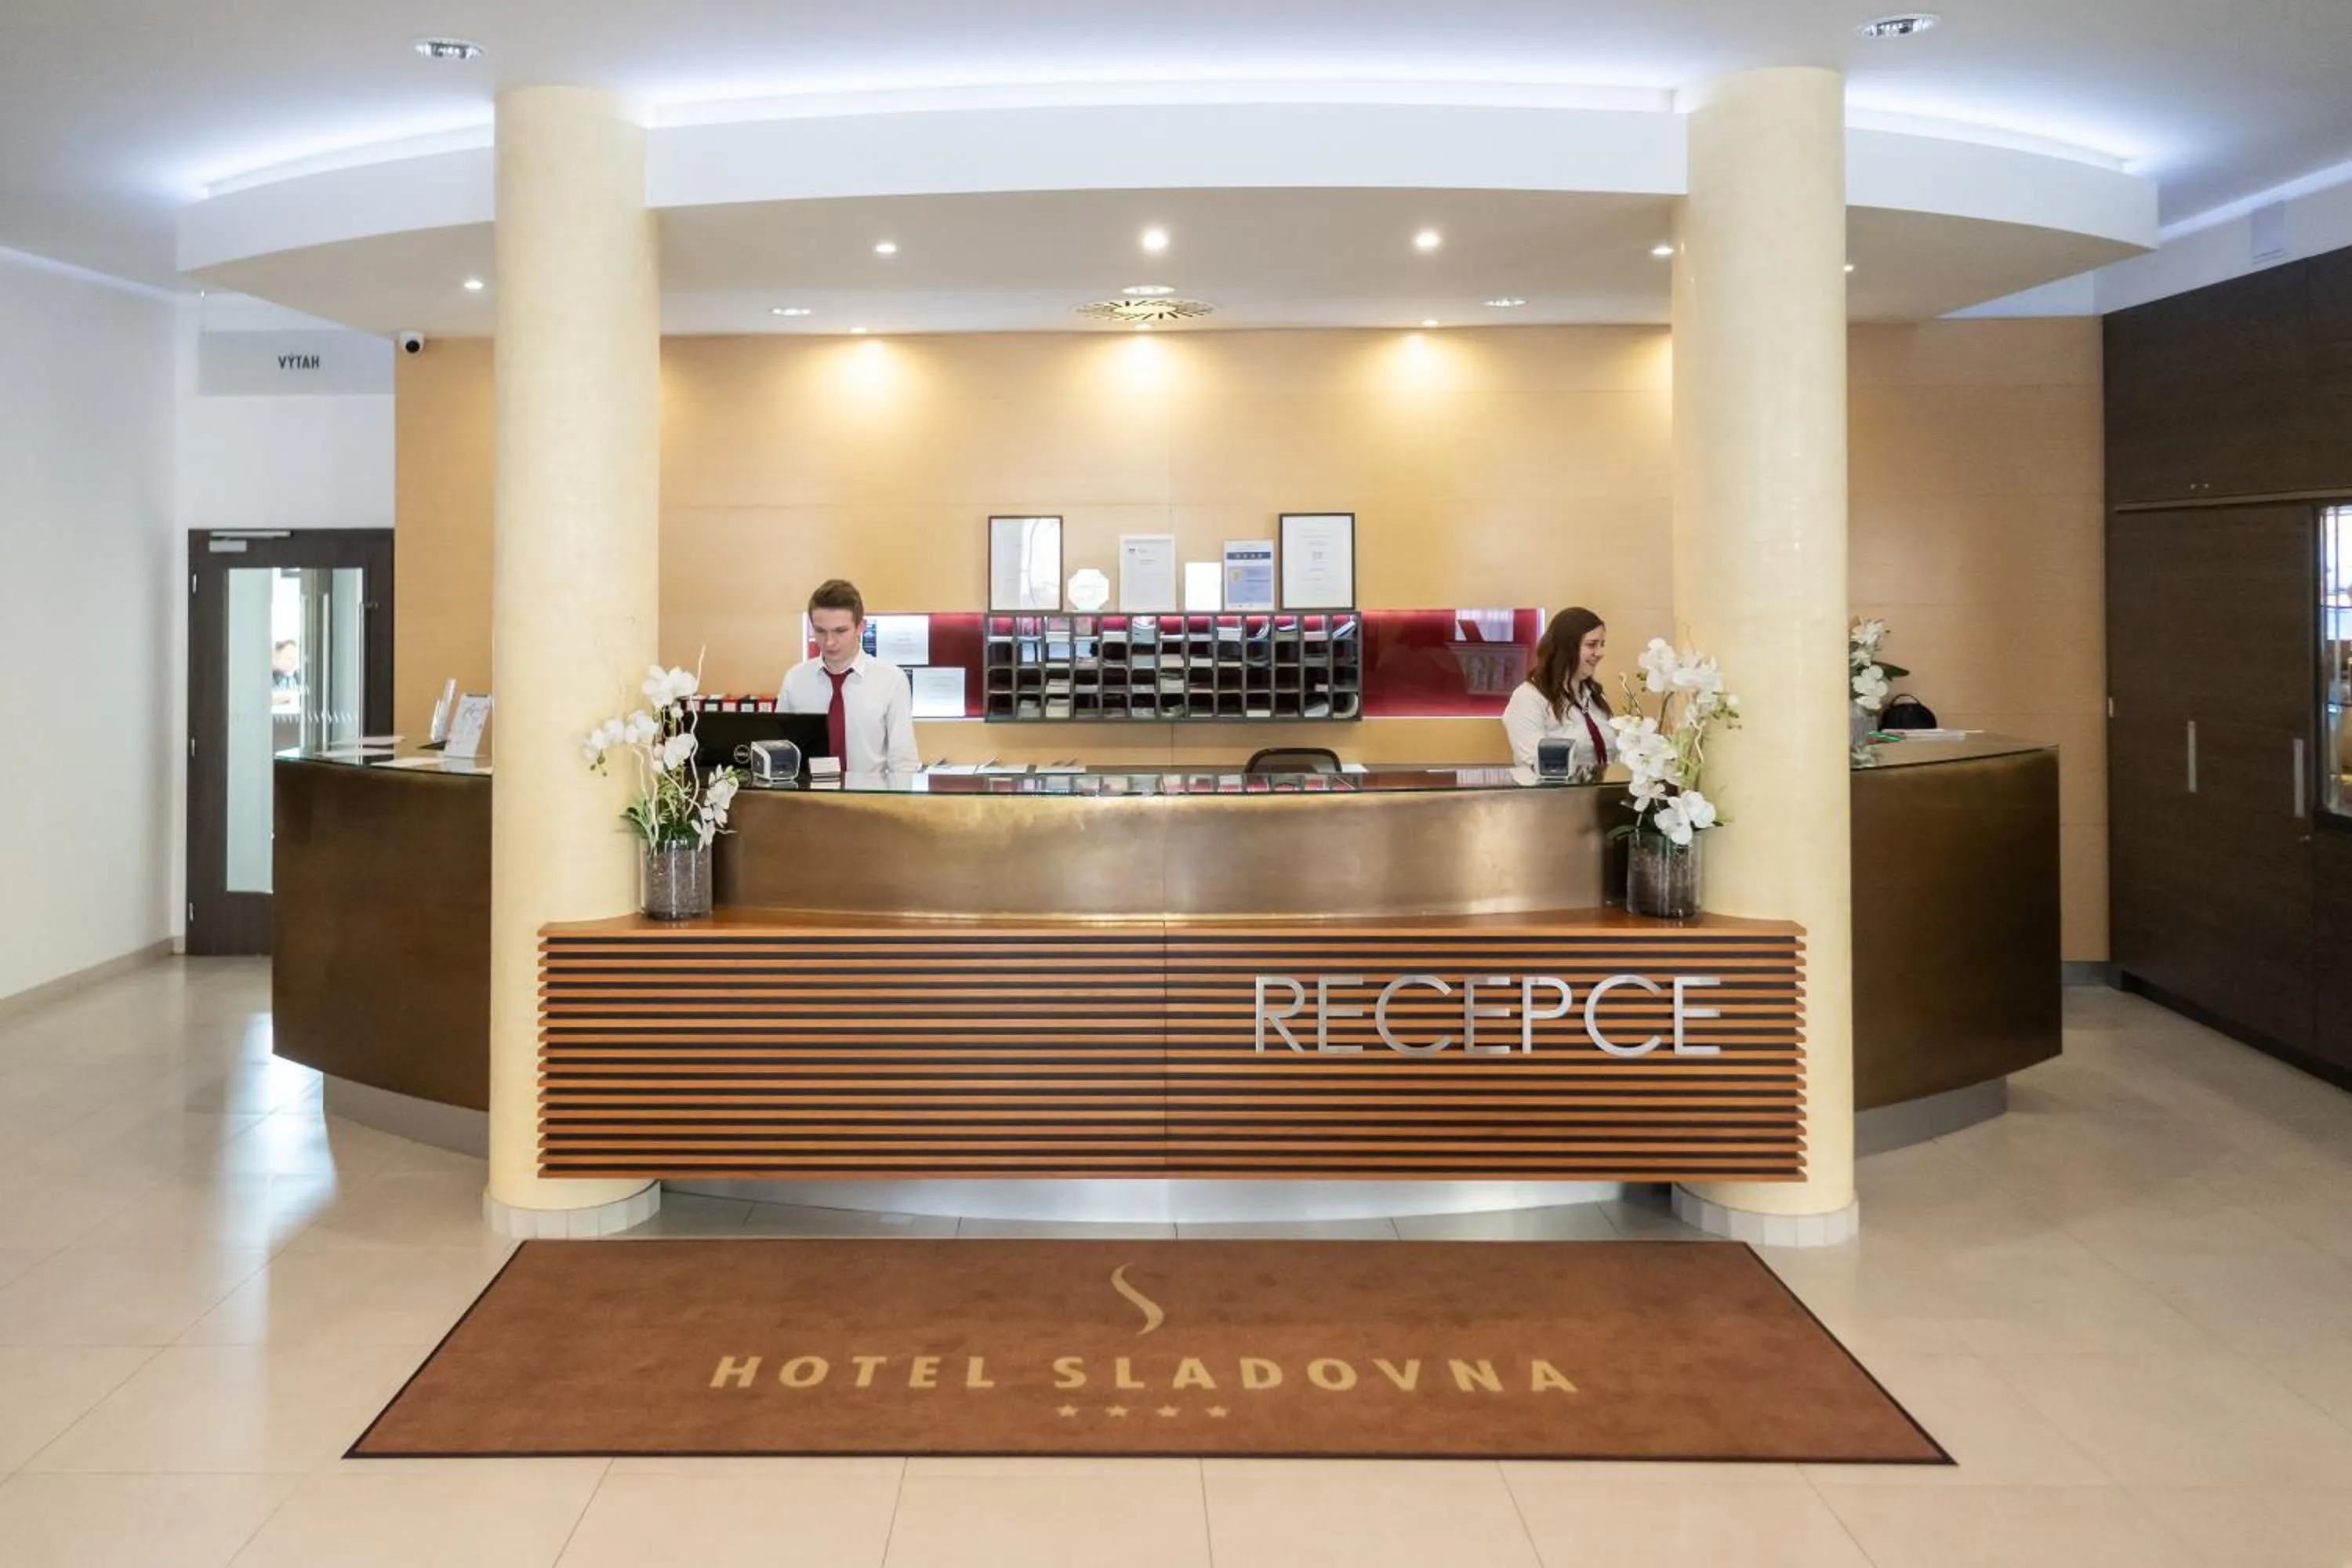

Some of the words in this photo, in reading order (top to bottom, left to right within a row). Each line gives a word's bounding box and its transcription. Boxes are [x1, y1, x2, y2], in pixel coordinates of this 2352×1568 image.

[1254, 975, 1722, 1057] RECEPCE
[709, 1356, 996, 1388] HOTEL
[1052, 1357, 1579, 1393] SLADOVNA
